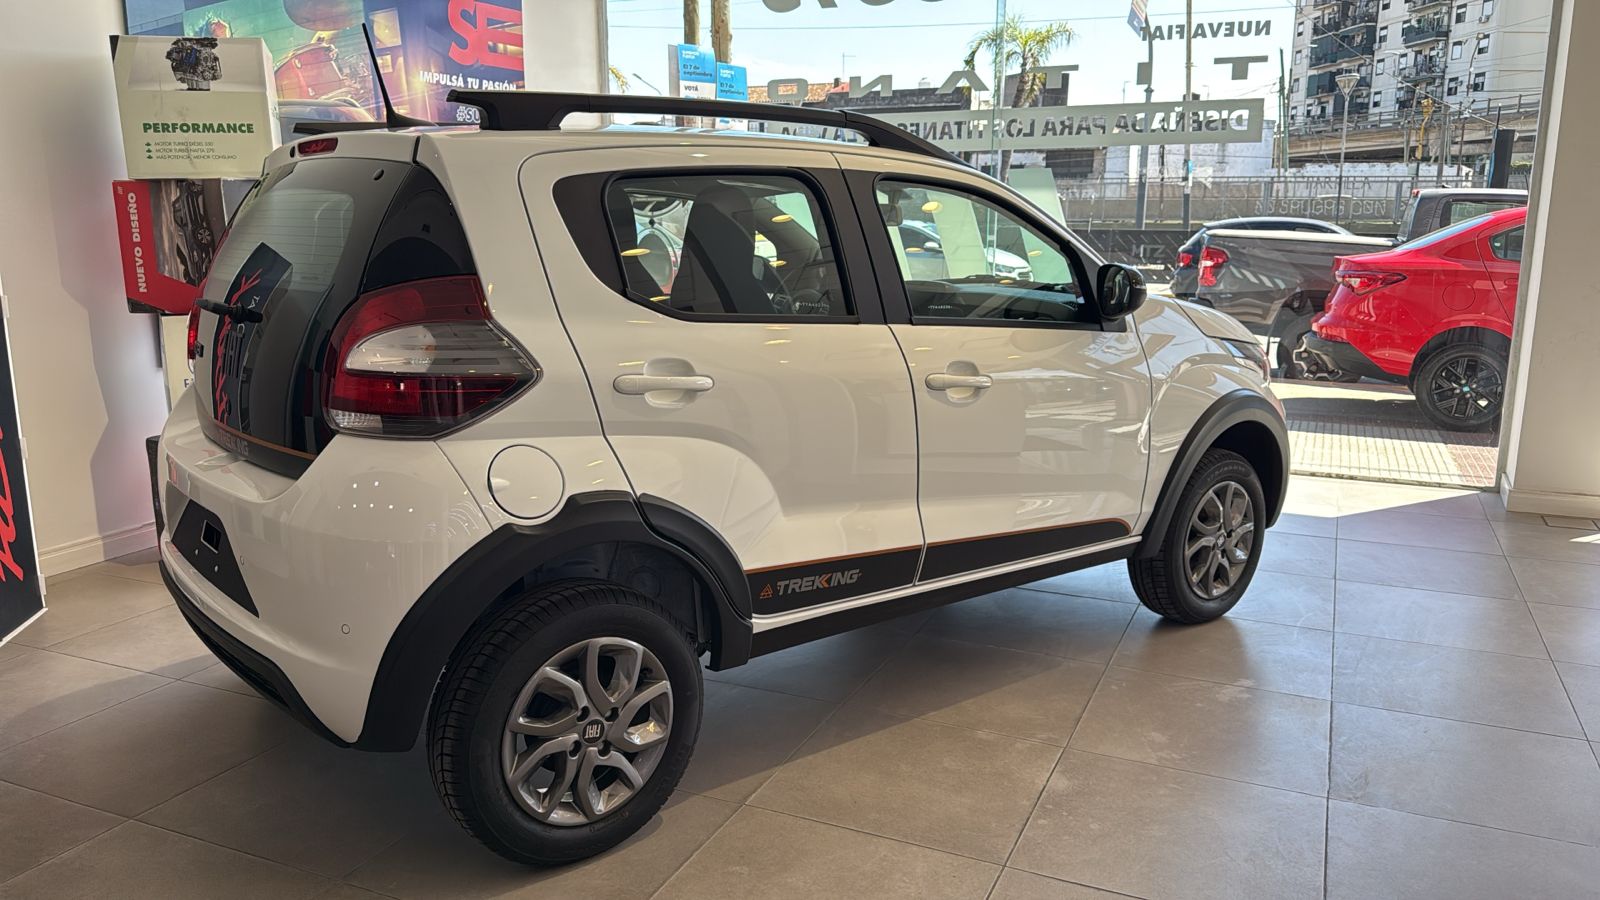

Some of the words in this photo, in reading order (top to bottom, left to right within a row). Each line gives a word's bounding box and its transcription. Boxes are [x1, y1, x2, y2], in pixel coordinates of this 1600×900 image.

[420, 70, 464, 88] IMPULSÁ
[467, 77, 479, 89] TU
[482, 80, 517, 91] PASIÓN
[142, 122, 254, 134] PERFORMANCE
[127, 192, 141, 242] DISEÑO
[134, 246, 148, 293] NUEVO
[777, 568, 862, 595] TREKKING
[584, 723, 601, 738] FIAT
